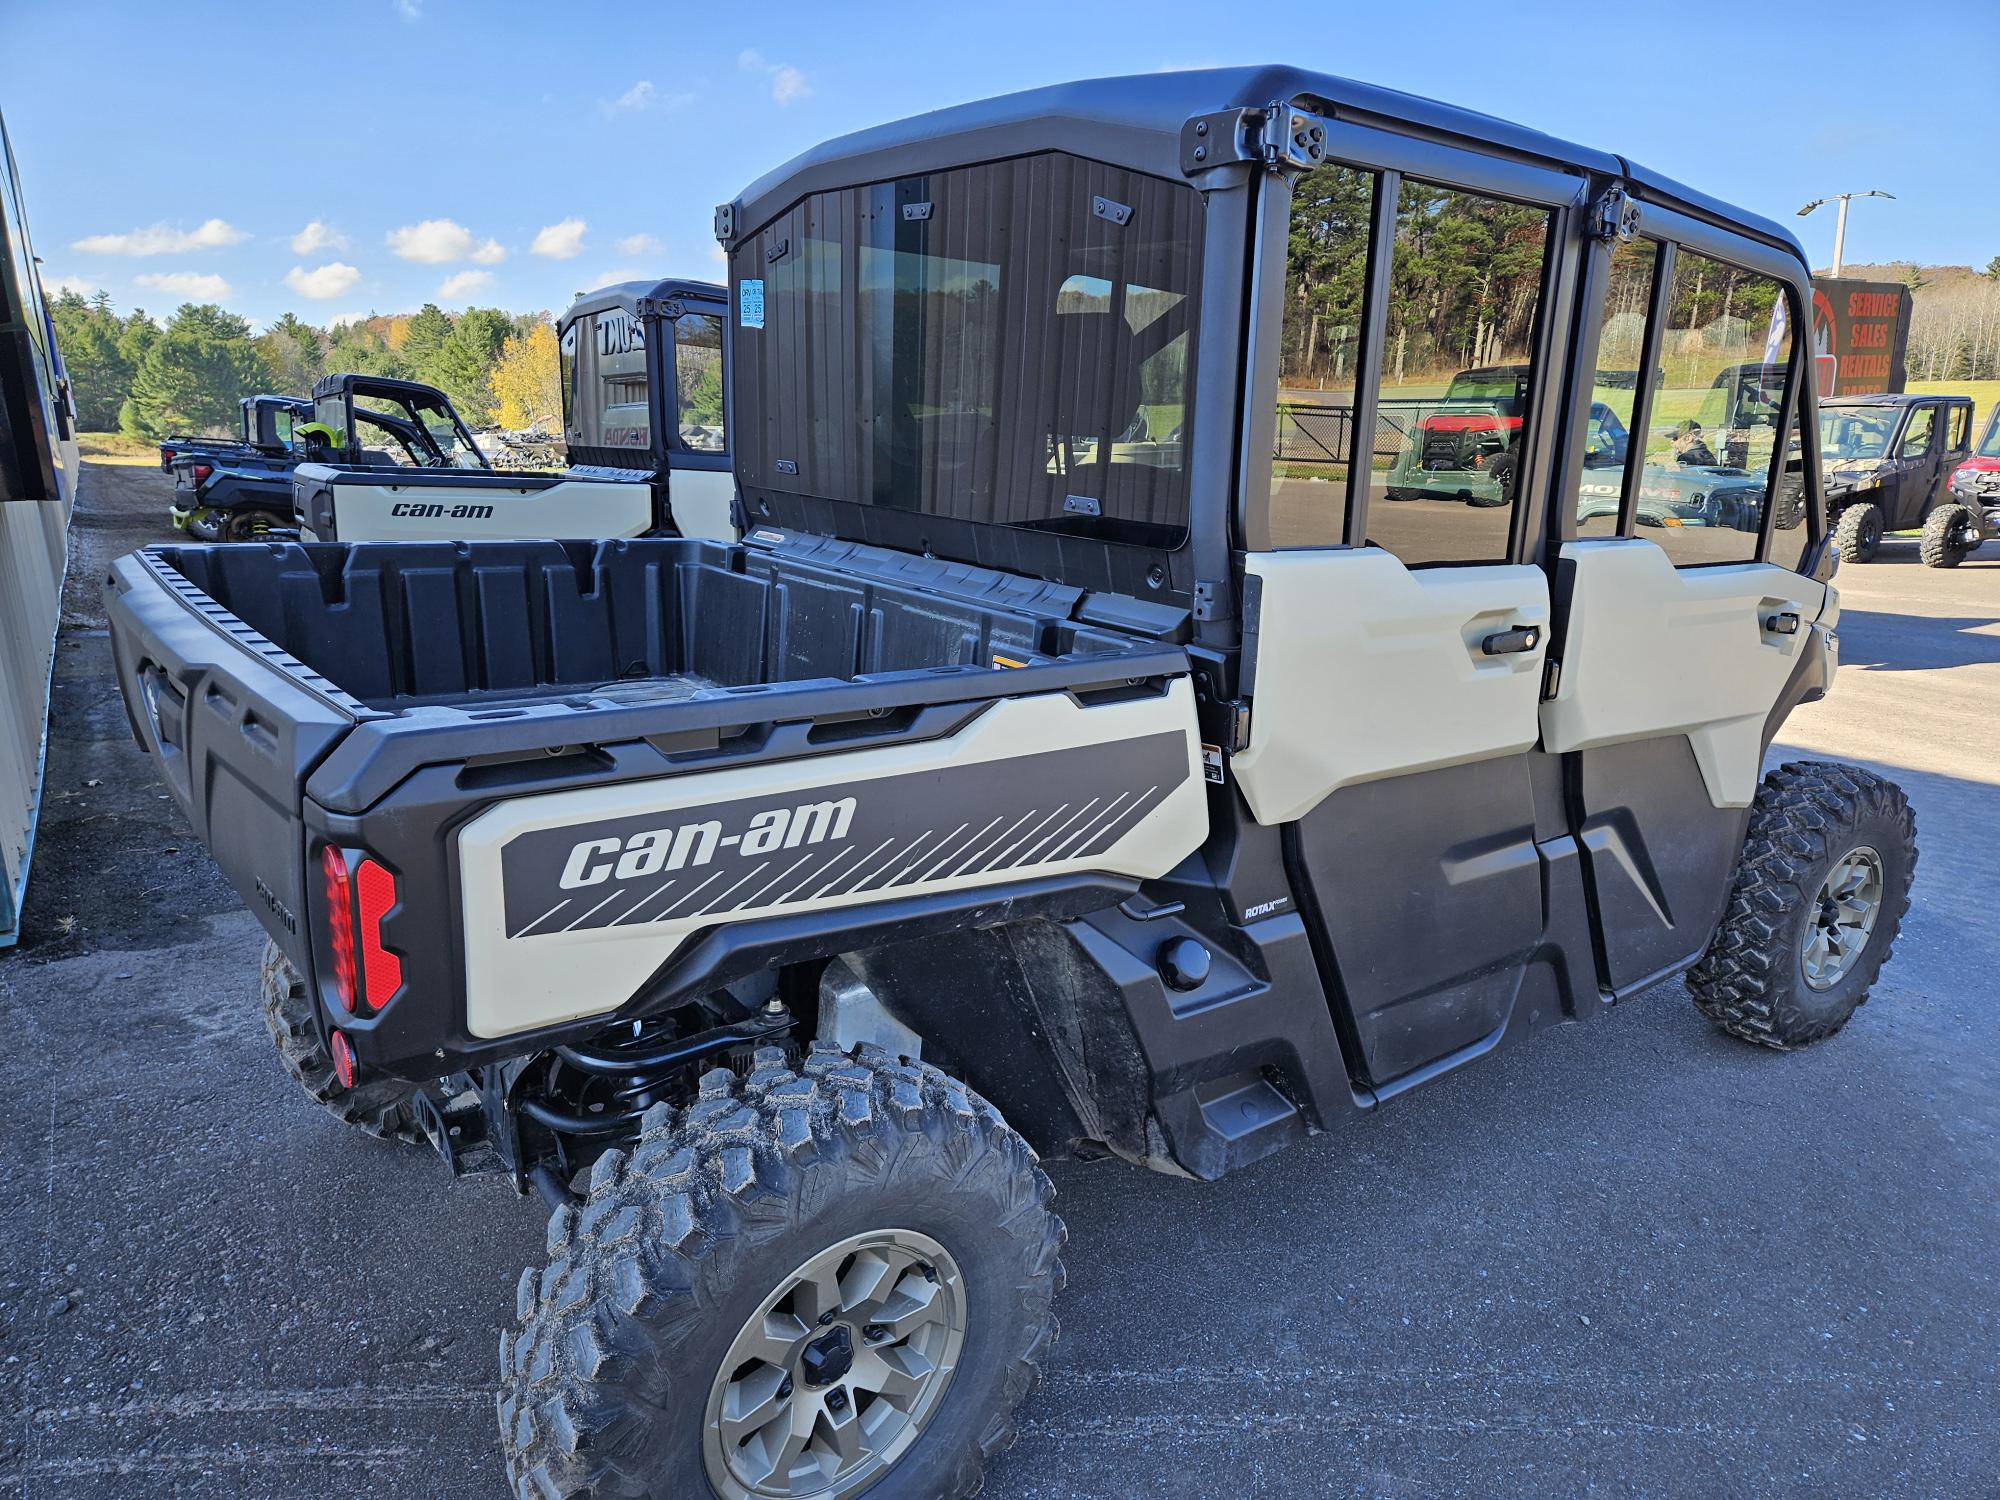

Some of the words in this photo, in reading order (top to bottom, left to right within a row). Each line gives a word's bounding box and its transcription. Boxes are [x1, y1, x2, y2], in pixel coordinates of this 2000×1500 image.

[1848, 292, 1898, 317] SERVICE
[1850, 323, 1888, 348] SALES
[1840, 354, 1889, 378] RENTALS
[391, 503, 494, 518] can-am
[559, 797, 857, 889] can-am
[1245, 901, 1275, 919] ROTAX
